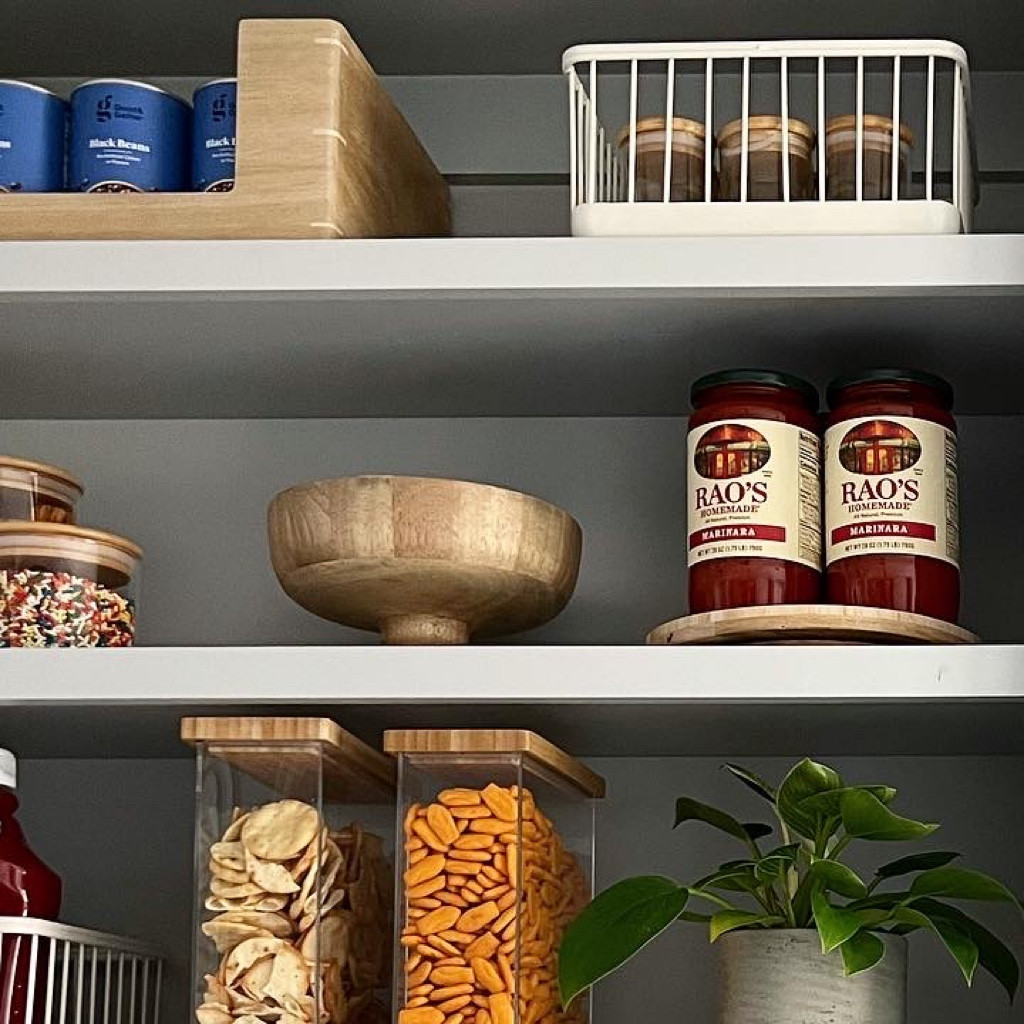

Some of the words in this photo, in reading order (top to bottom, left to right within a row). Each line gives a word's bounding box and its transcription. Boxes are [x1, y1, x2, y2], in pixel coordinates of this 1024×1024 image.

[89, 138, 115, 148] Black
[118, 139, 150, 152] Beans
[696, 481, 768, 510] RAO'S
[841, 477, 920, 506] RAO'S
[700, 505, 759, 518] HOMEMADE
[848, 502, 911, 513] HOMEMADE
[702, 527, 756, 541] MARINARA
[850, 524, 908, 536] MARINARA
